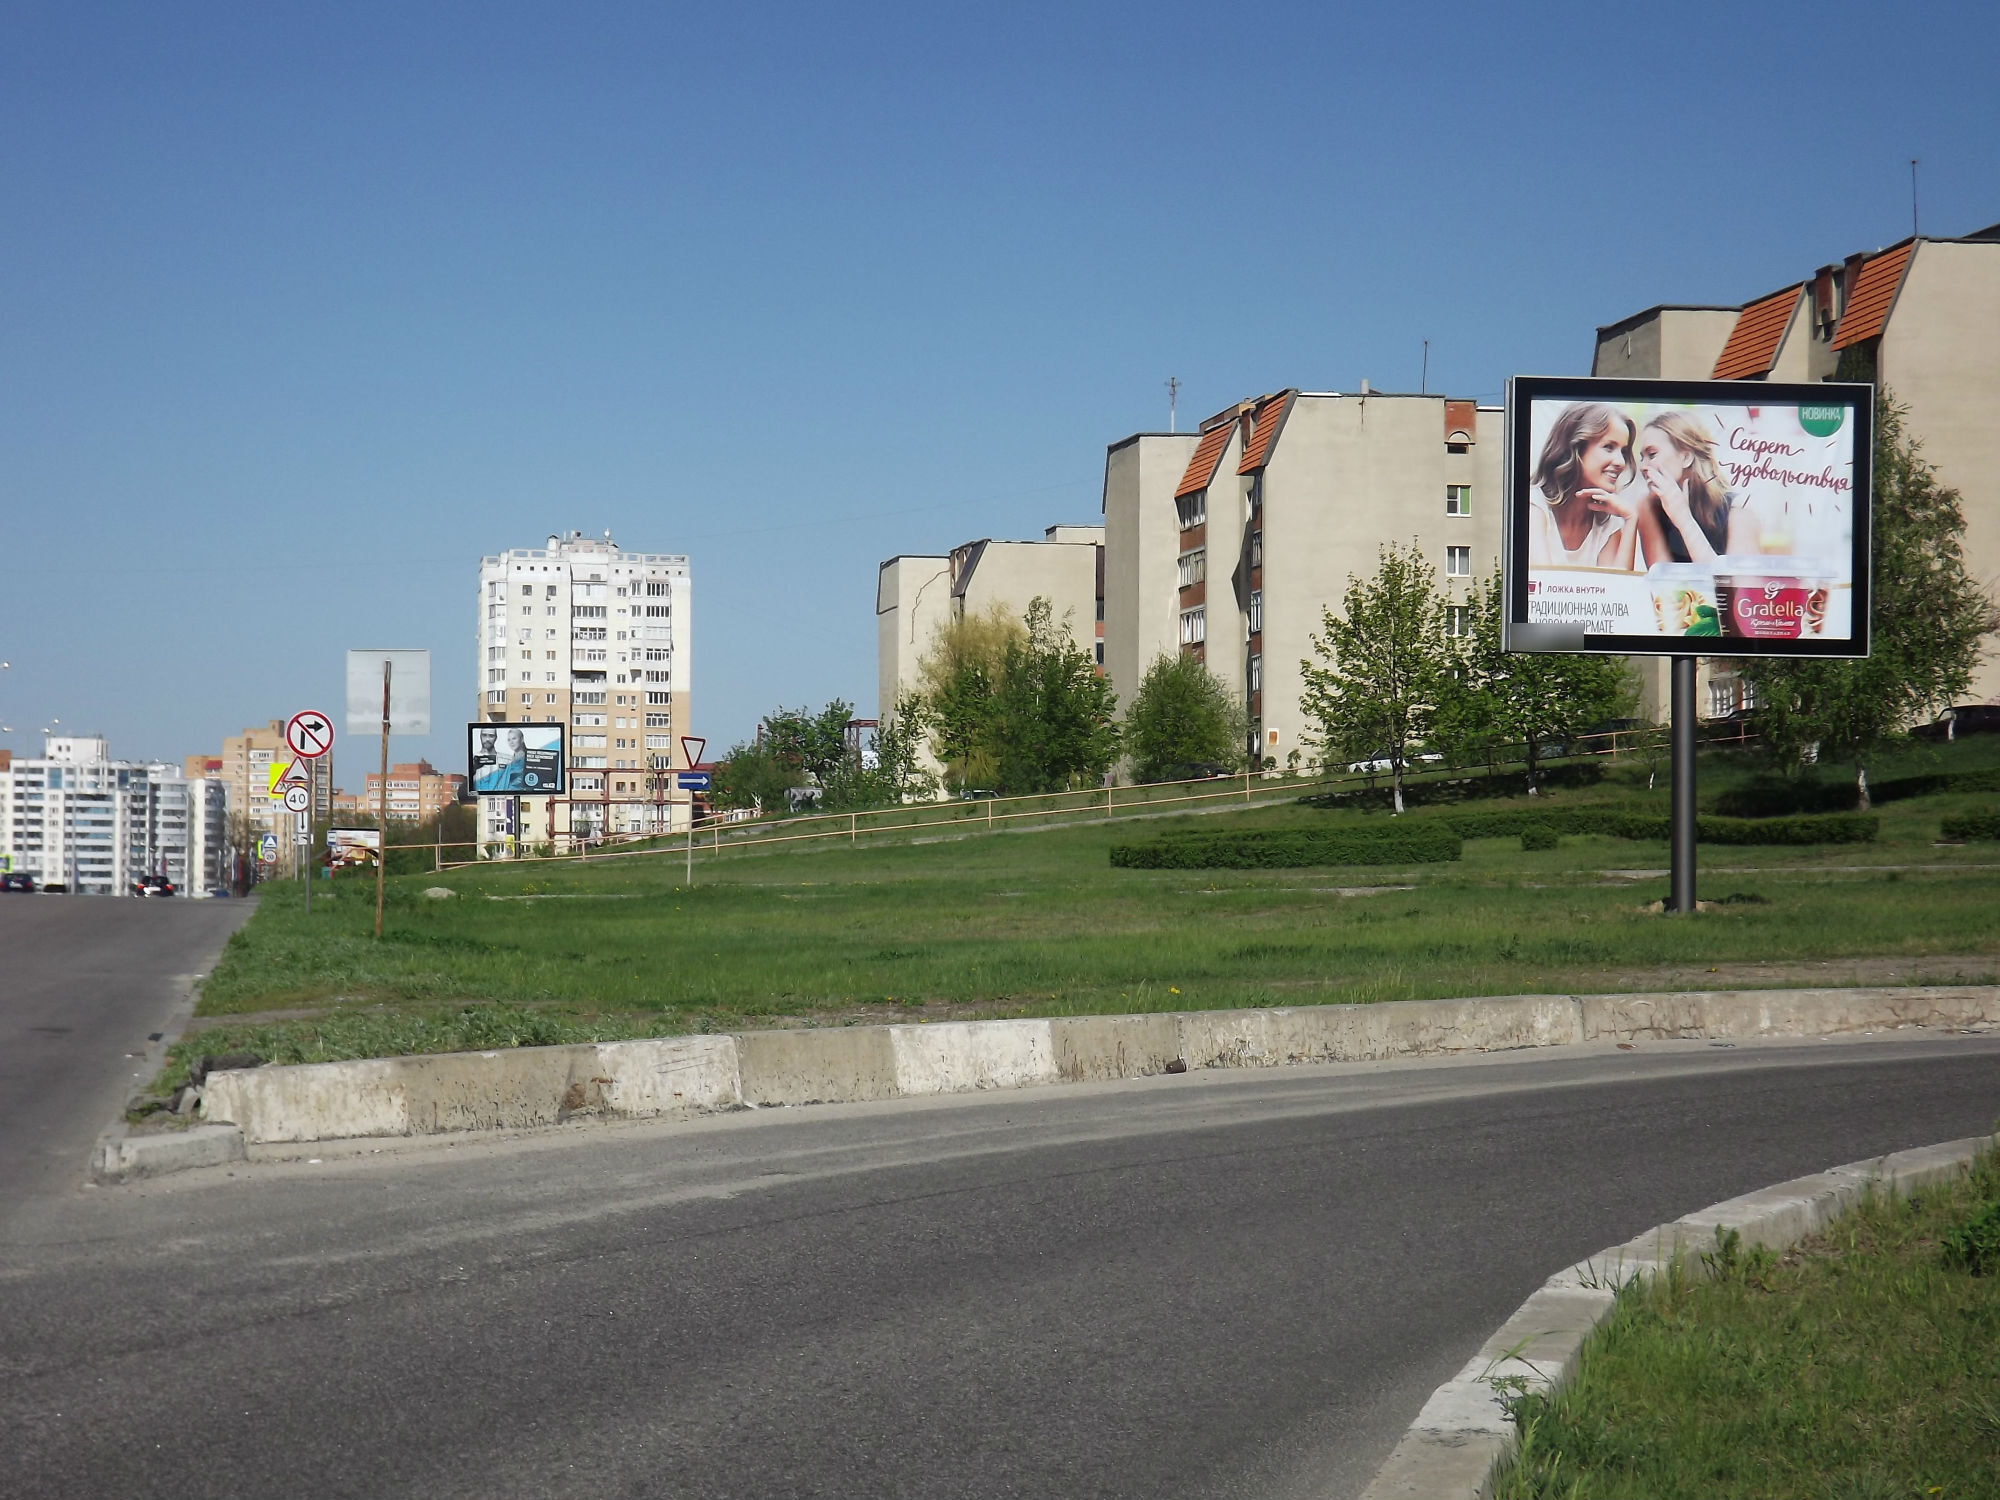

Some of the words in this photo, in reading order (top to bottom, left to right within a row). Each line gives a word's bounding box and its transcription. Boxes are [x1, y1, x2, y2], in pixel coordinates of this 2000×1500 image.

[1802, 407, 1841, 420] НОВИНКА
[1729, 426, 1805, 463] Секрет
[1719, 456, 1853, 495] удовольствия
[1547, 585, 1574, 594] ЛОЖКА
[1576, 586, 1606, 594] ВНУТРИ
[1601, 602, 1630, 617] ХАЛВА
[1737, 598, 1804, 618] Gratella
[289, 793, 306, 804] 40
